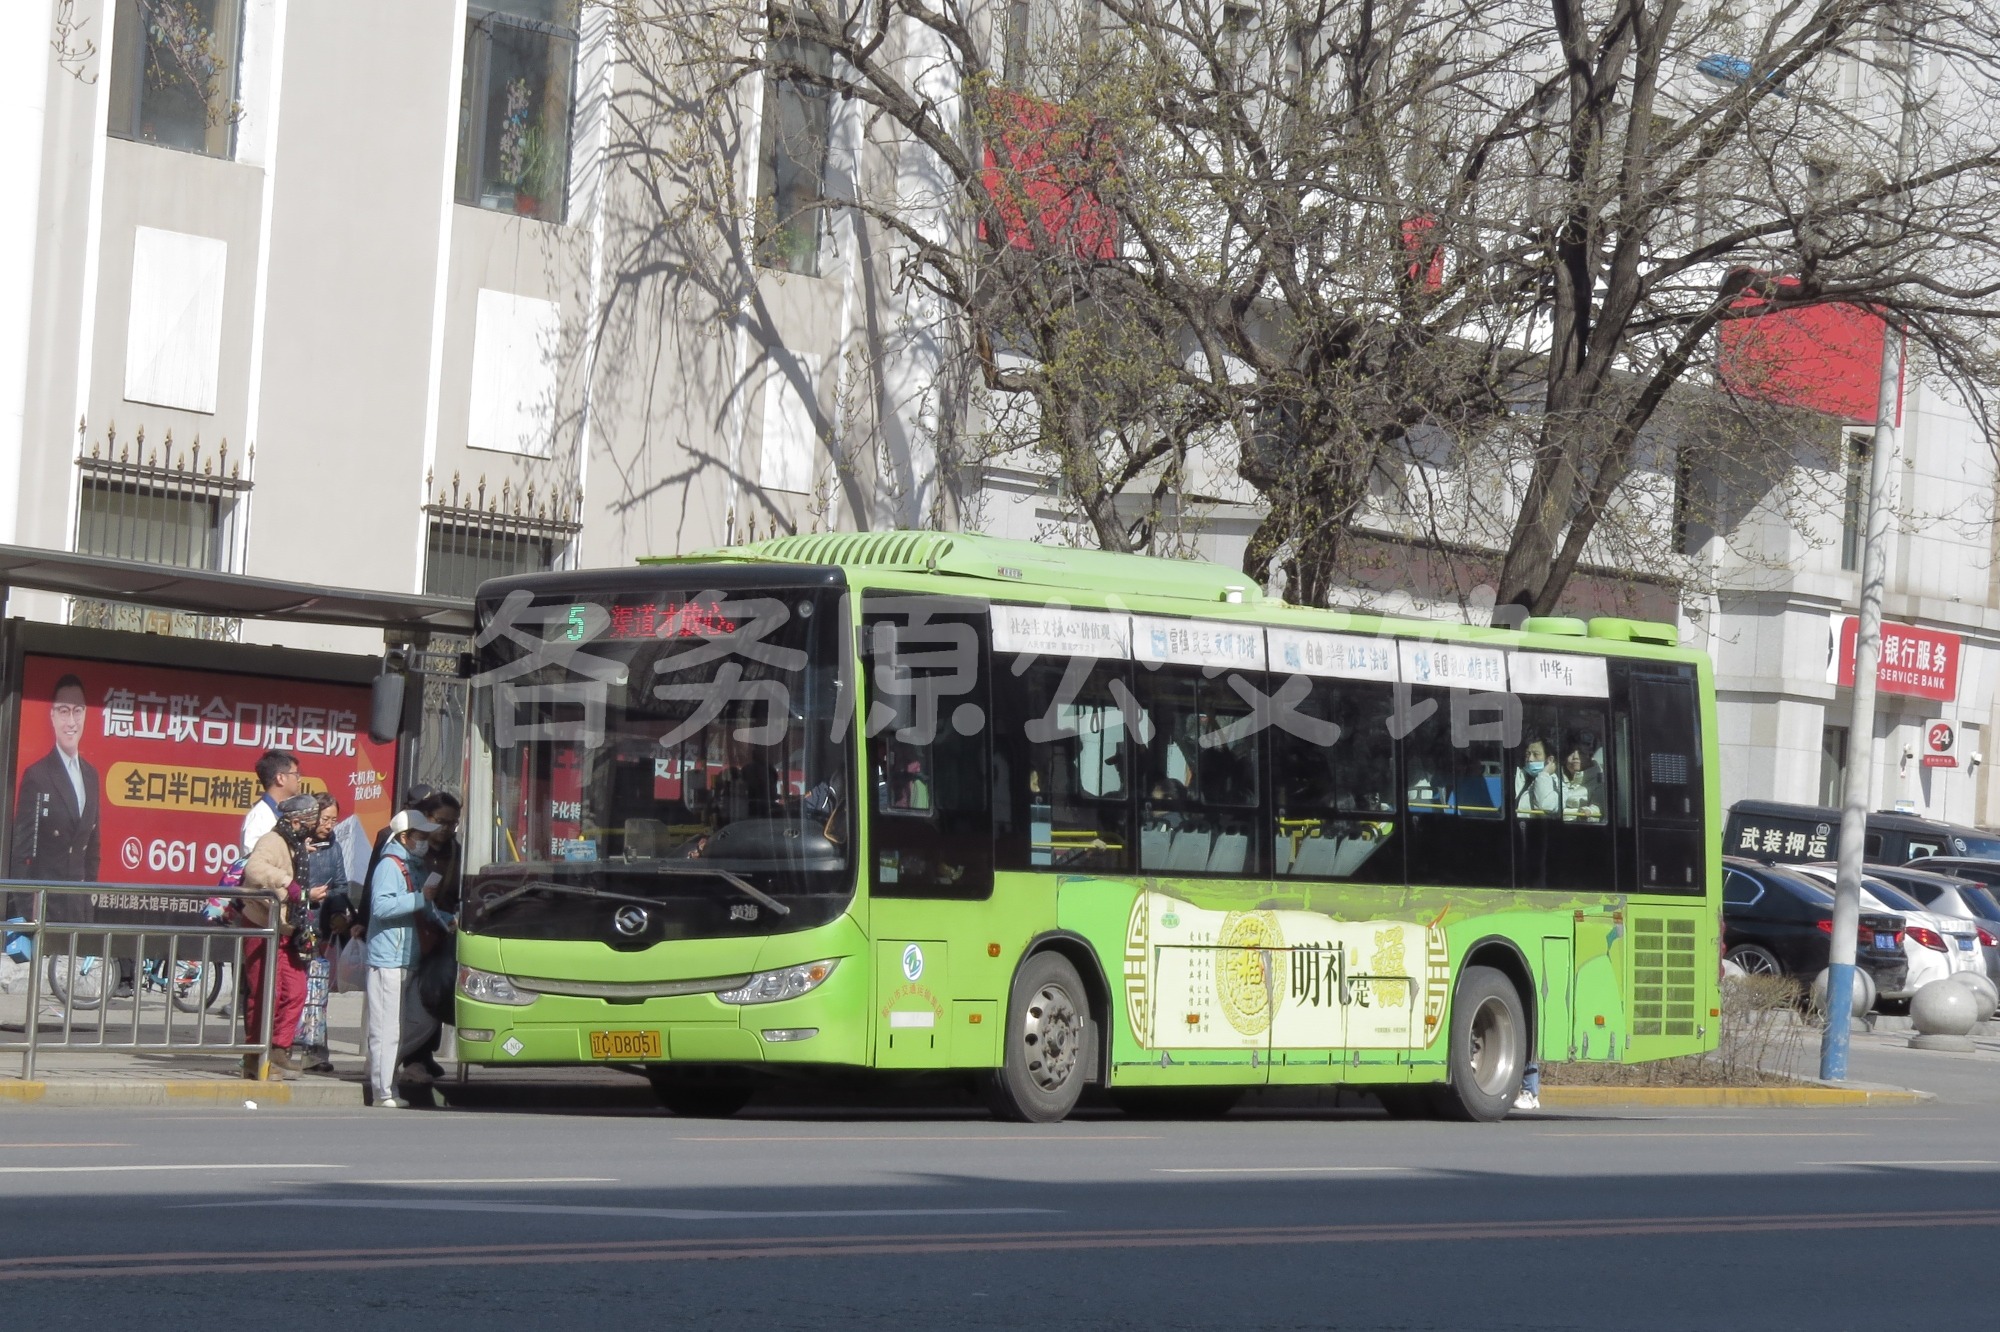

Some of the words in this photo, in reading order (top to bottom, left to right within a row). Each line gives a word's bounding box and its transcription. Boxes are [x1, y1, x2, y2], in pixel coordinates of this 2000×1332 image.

[566, 606, 586, 641] 5
[1010, 616, 1111, 641] 社会主义核心价值观
[1852, 633, 1947, 673] 银行服务
[1540, 658, 1573, 686] 中华有
[1851, 663, 1918, 685] S-SERVICE
[1921, 674, 1945, 690] BANK
[103, 687, 357, 757] 德立联合口腔医院
[1932, 729, 1950, 745] 24
[124, 768, 316, 810] 全口半口种植
[348, 770, 376, 787] 大机构
[355, 784, 382, 801] 放心种
[149, 838, 197, 873] 661
[1740, 827, 1828, 859] 武装押运
[505, 1042, 520, 1050] LNG
